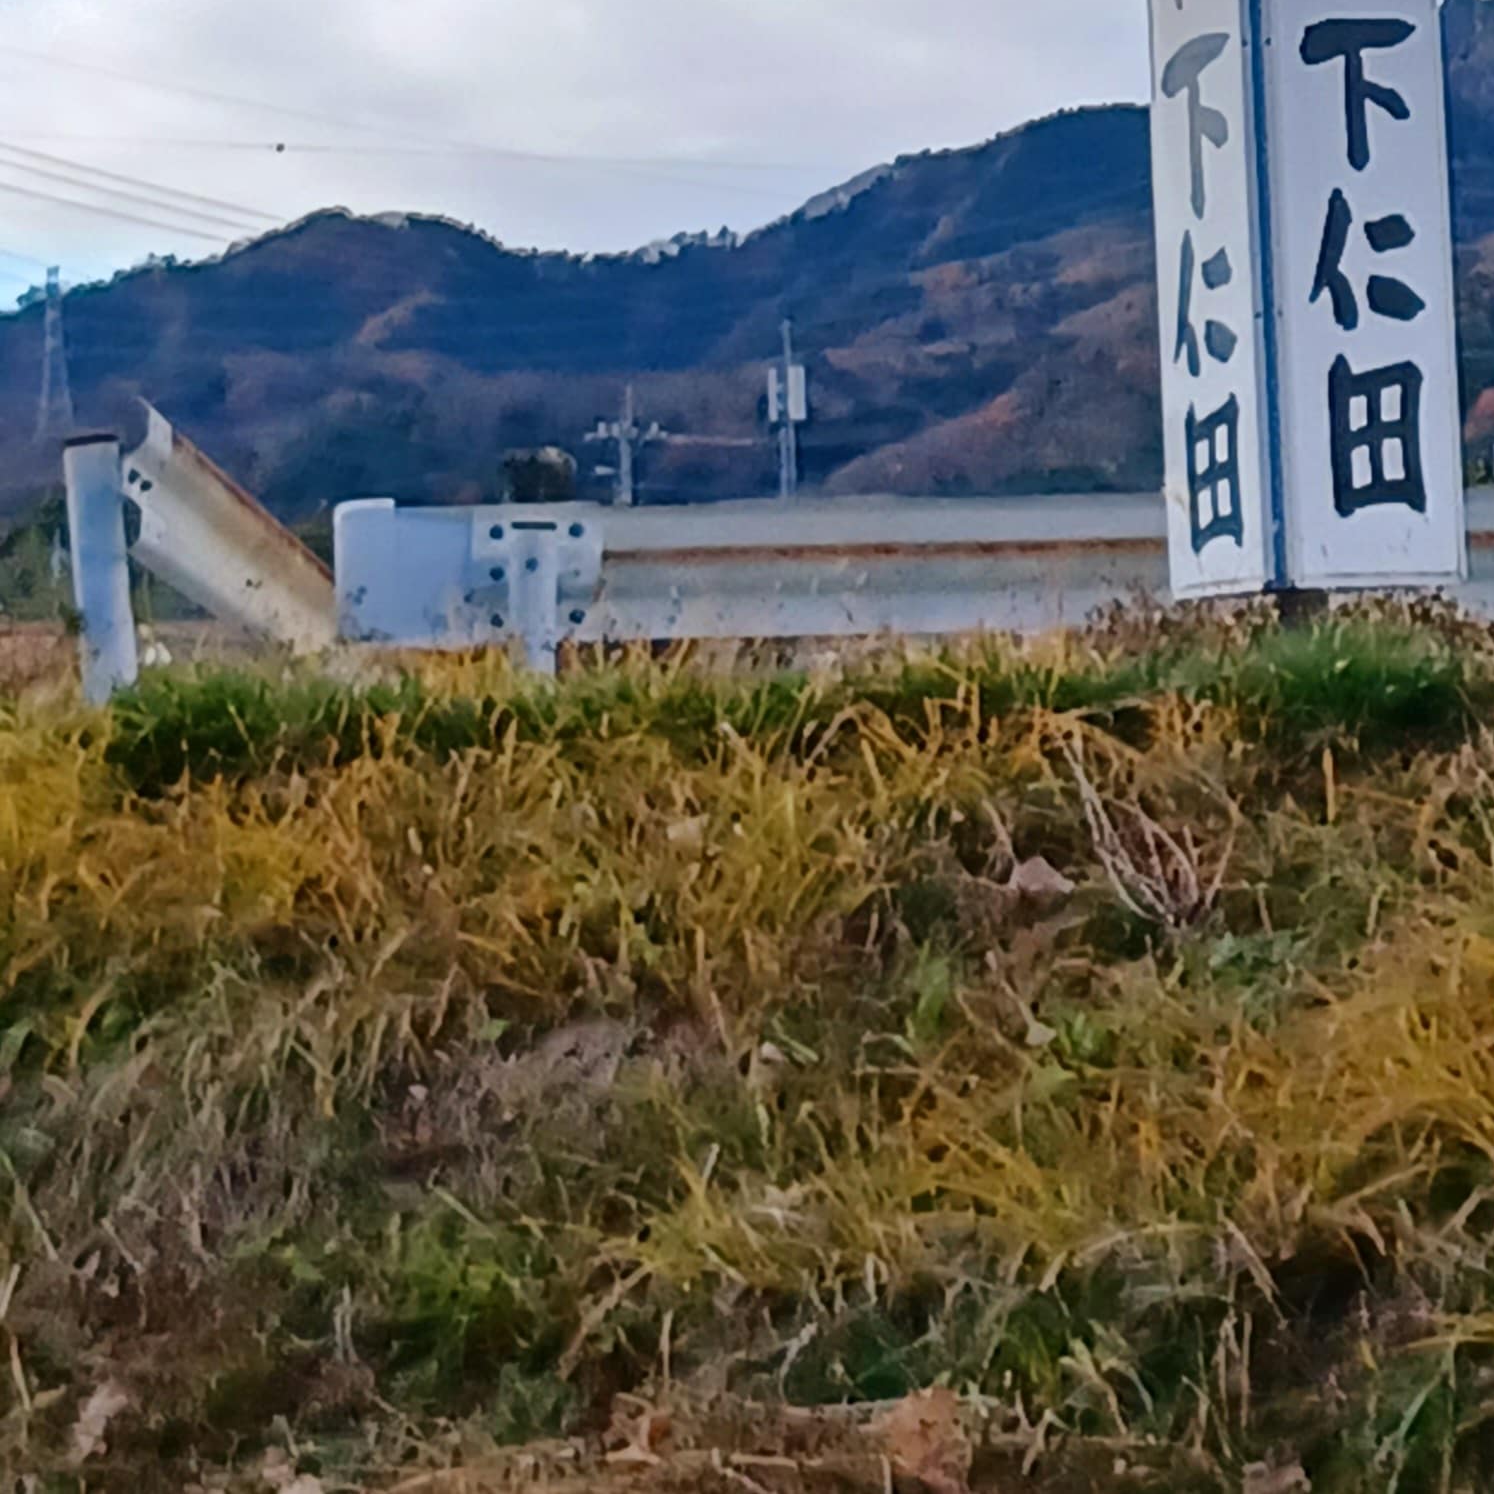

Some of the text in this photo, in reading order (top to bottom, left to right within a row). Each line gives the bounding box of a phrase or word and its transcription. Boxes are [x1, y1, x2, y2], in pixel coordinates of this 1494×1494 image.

[1161, 31, 1244, 553] 下仁田
[1299, 16, 1427, 519] 下仁田
